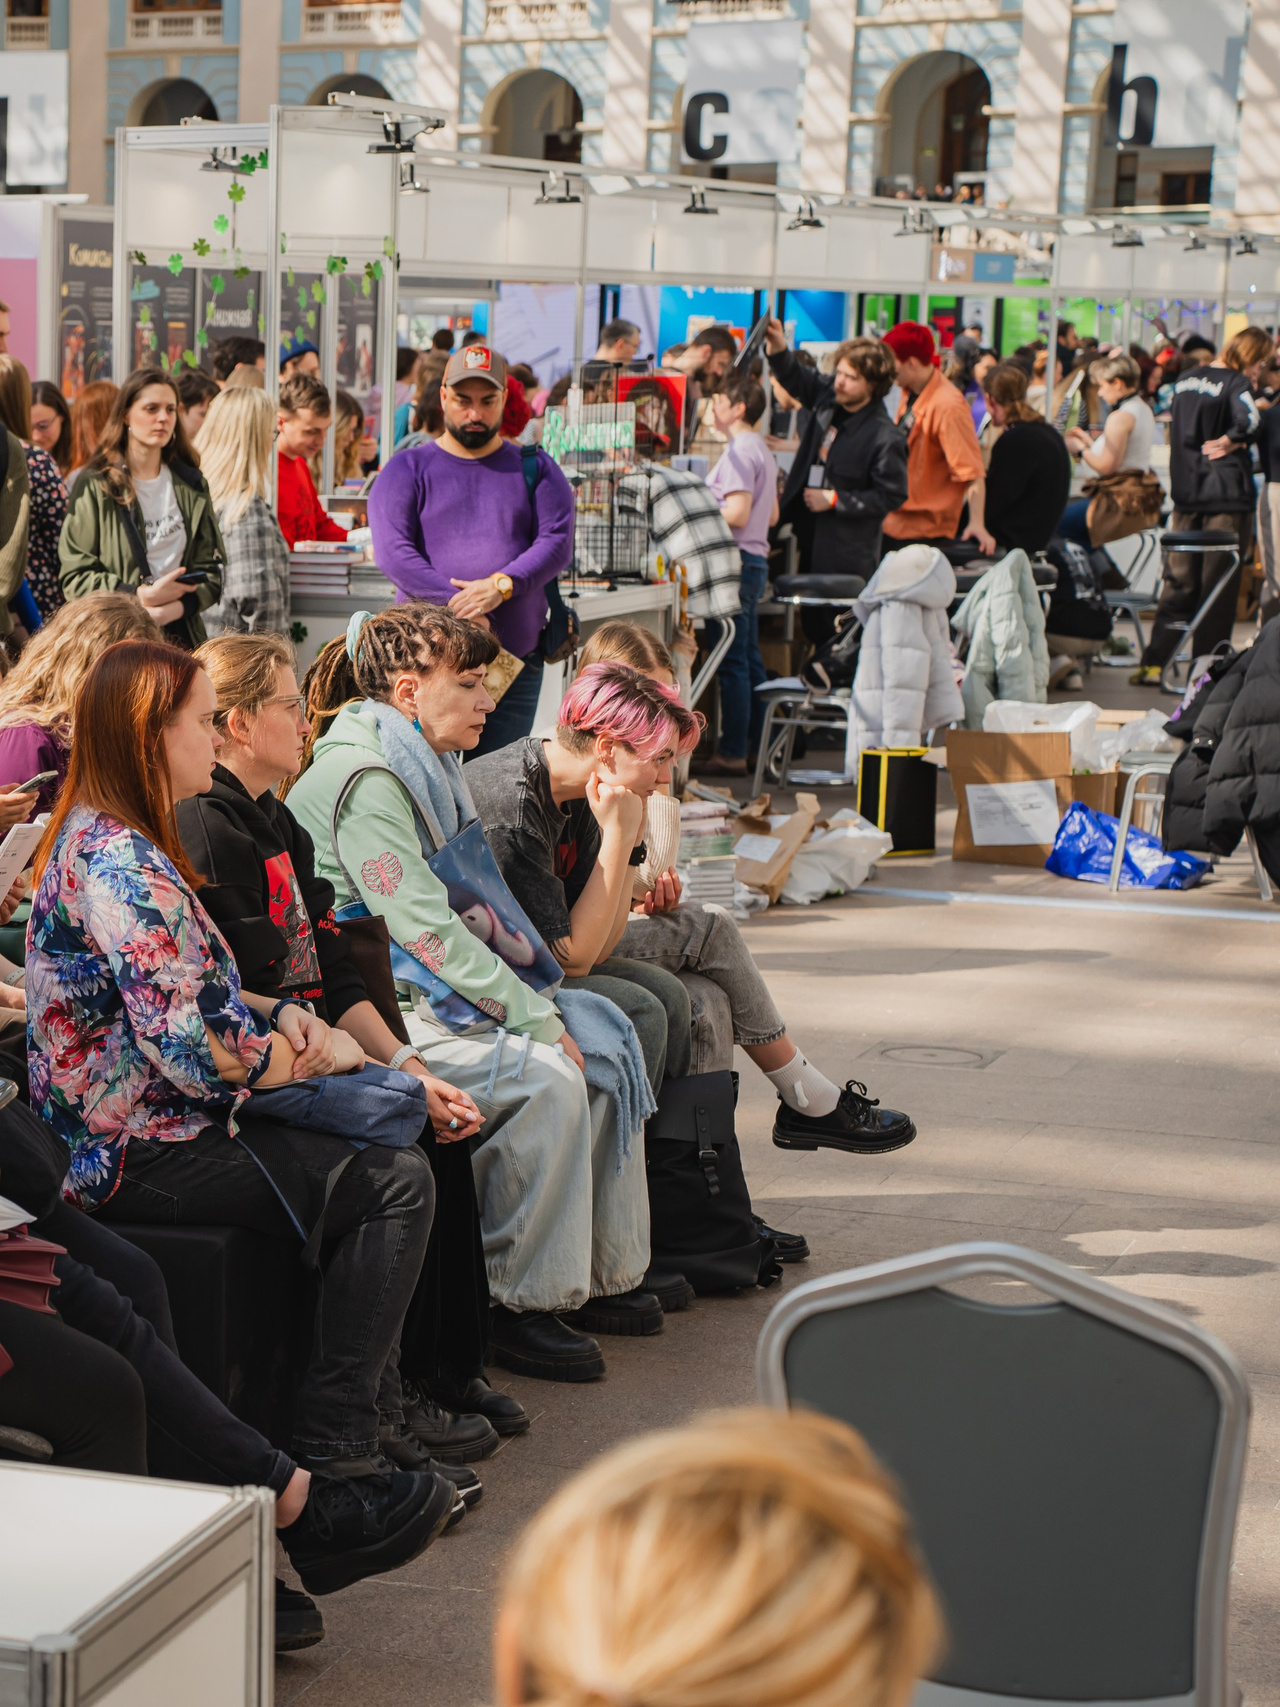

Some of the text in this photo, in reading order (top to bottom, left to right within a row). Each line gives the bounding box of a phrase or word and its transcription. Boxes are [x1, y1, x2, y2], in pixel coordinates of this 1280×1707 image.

[685, 91, 729, 161] c
[1108, 44, 1159, 146] b
[302, 988, 323, 999] THERE
